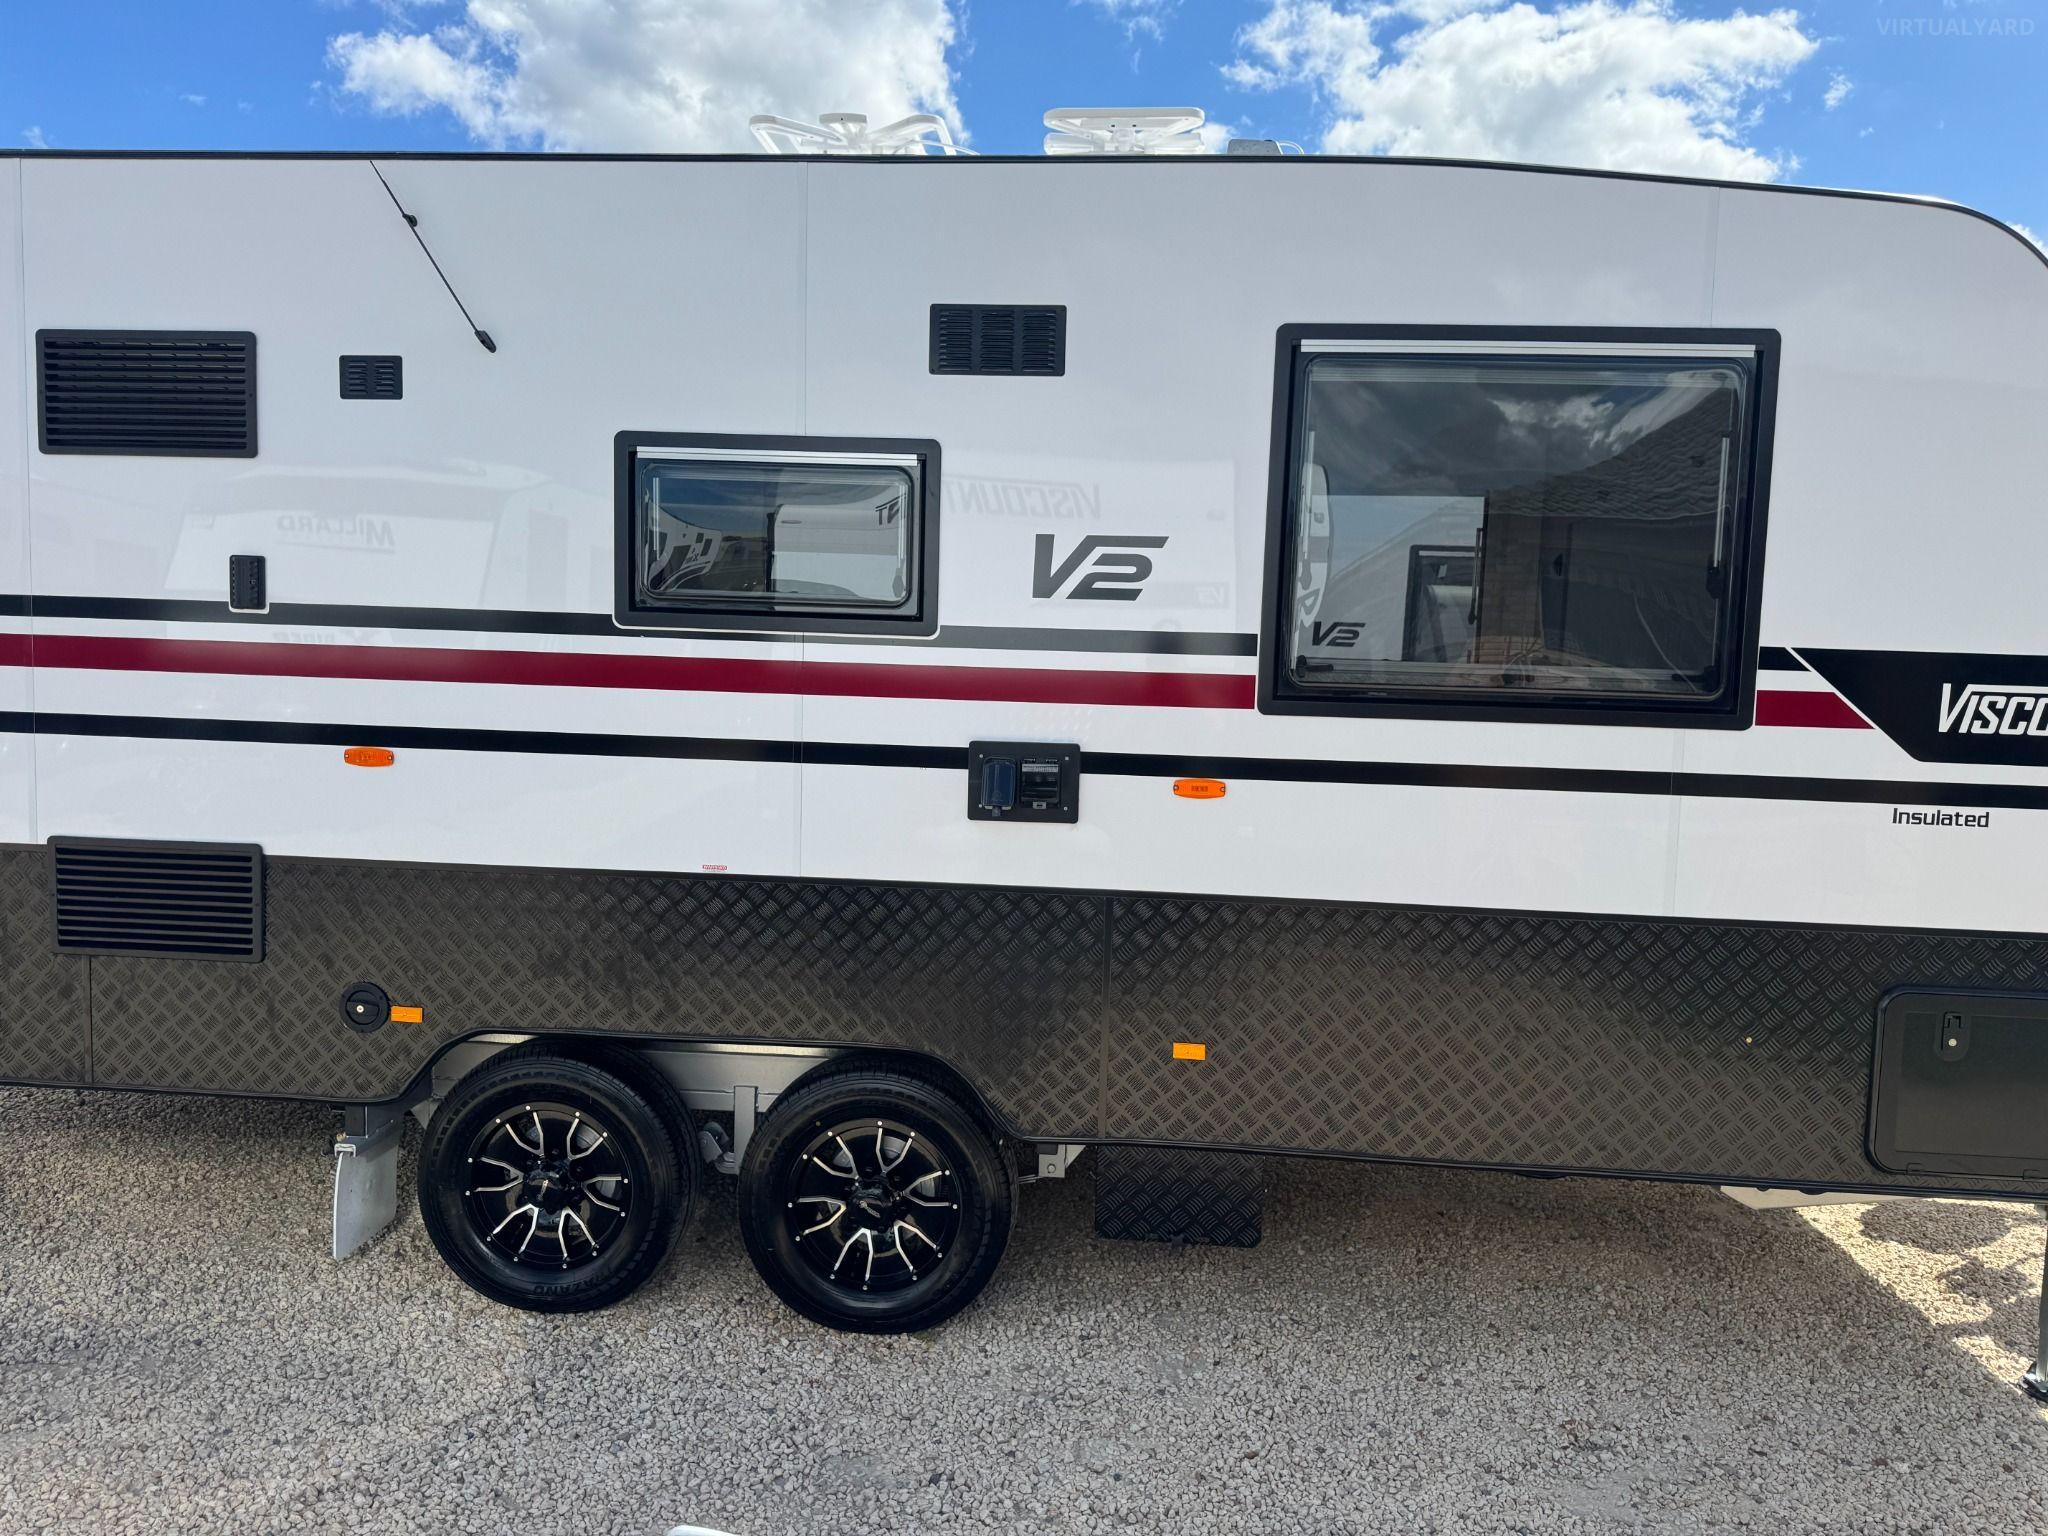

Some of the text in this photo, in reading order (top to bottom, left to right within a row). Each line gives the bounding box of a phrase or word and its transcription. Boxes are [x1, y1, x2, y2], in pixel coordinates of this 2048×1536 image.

[1032, 533, 1169, 602] V2
[1312, 620, 1366, 648] V2
[1892, 807, 1990, 828] Insulated
